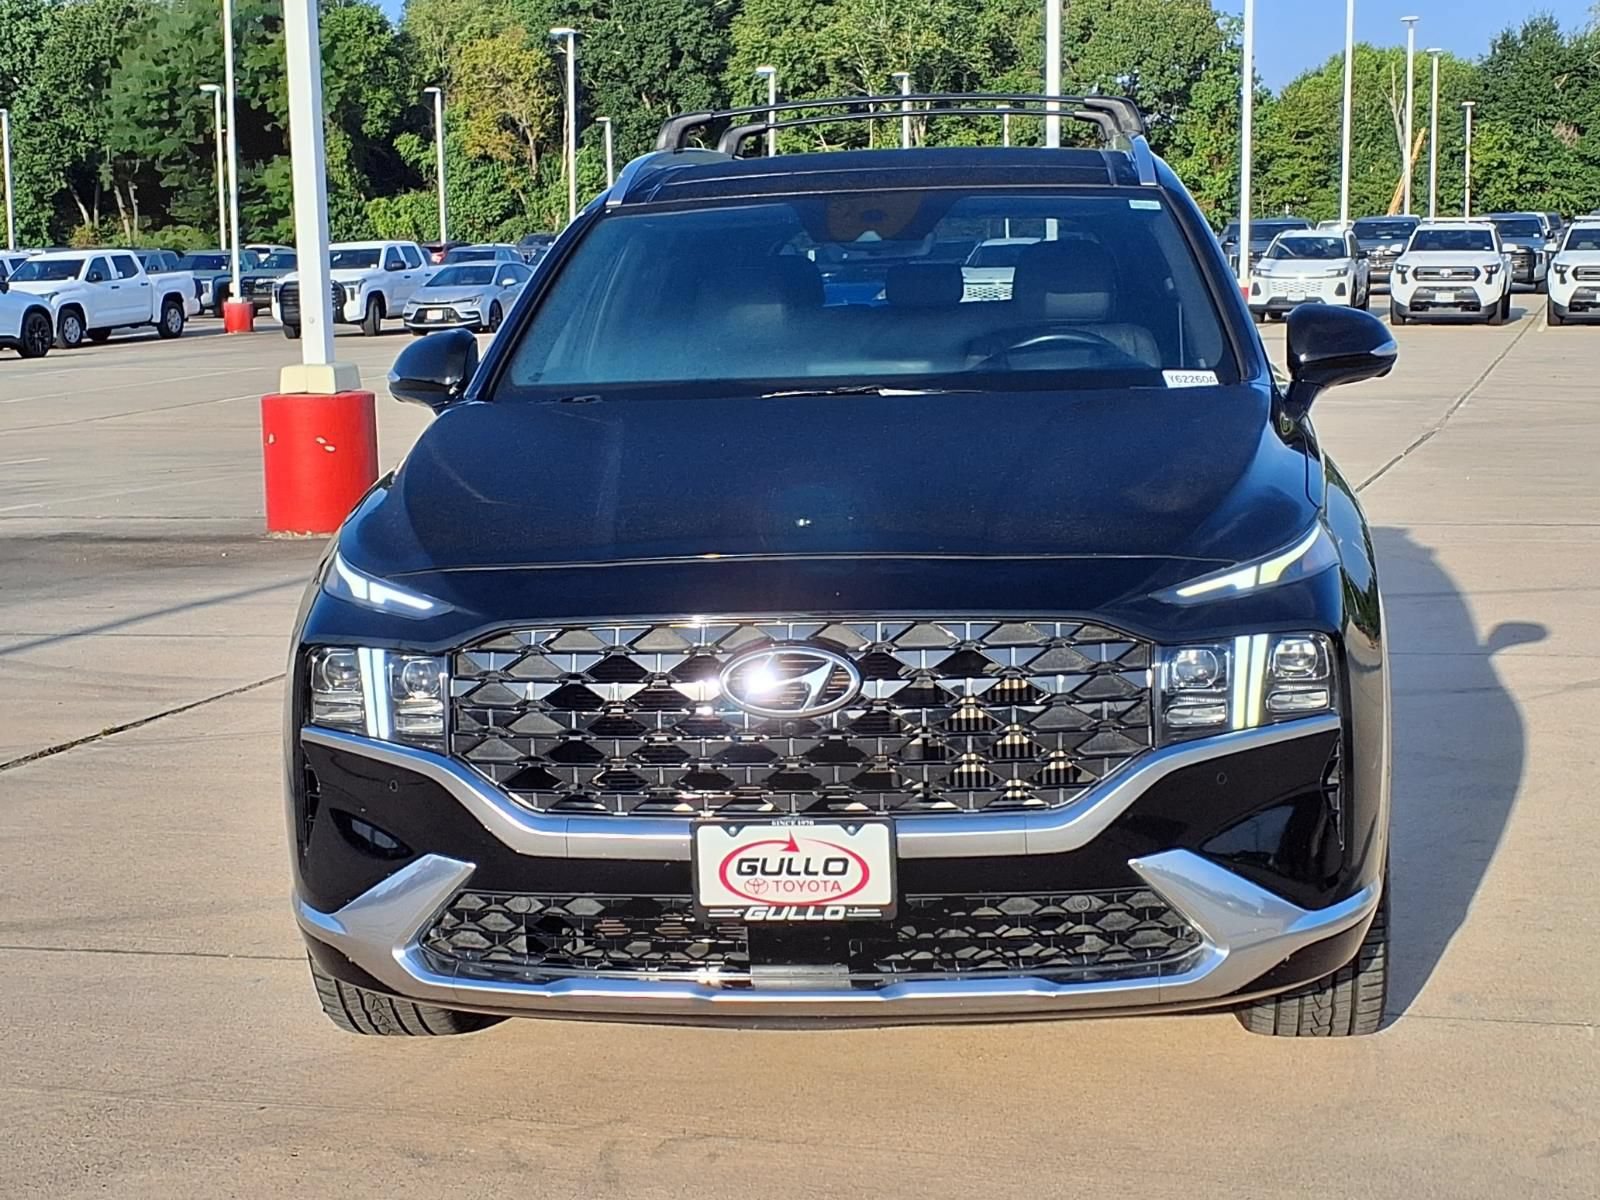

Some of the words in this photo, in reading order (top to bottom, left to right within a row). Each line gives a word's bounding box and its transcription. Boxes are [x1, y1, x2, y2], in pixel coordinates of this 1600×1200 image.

[736, 857, 849, 876] GULLO
[772, 879, 842, 893] TOYOTA
[743, 906, 846, 921] GULLO
